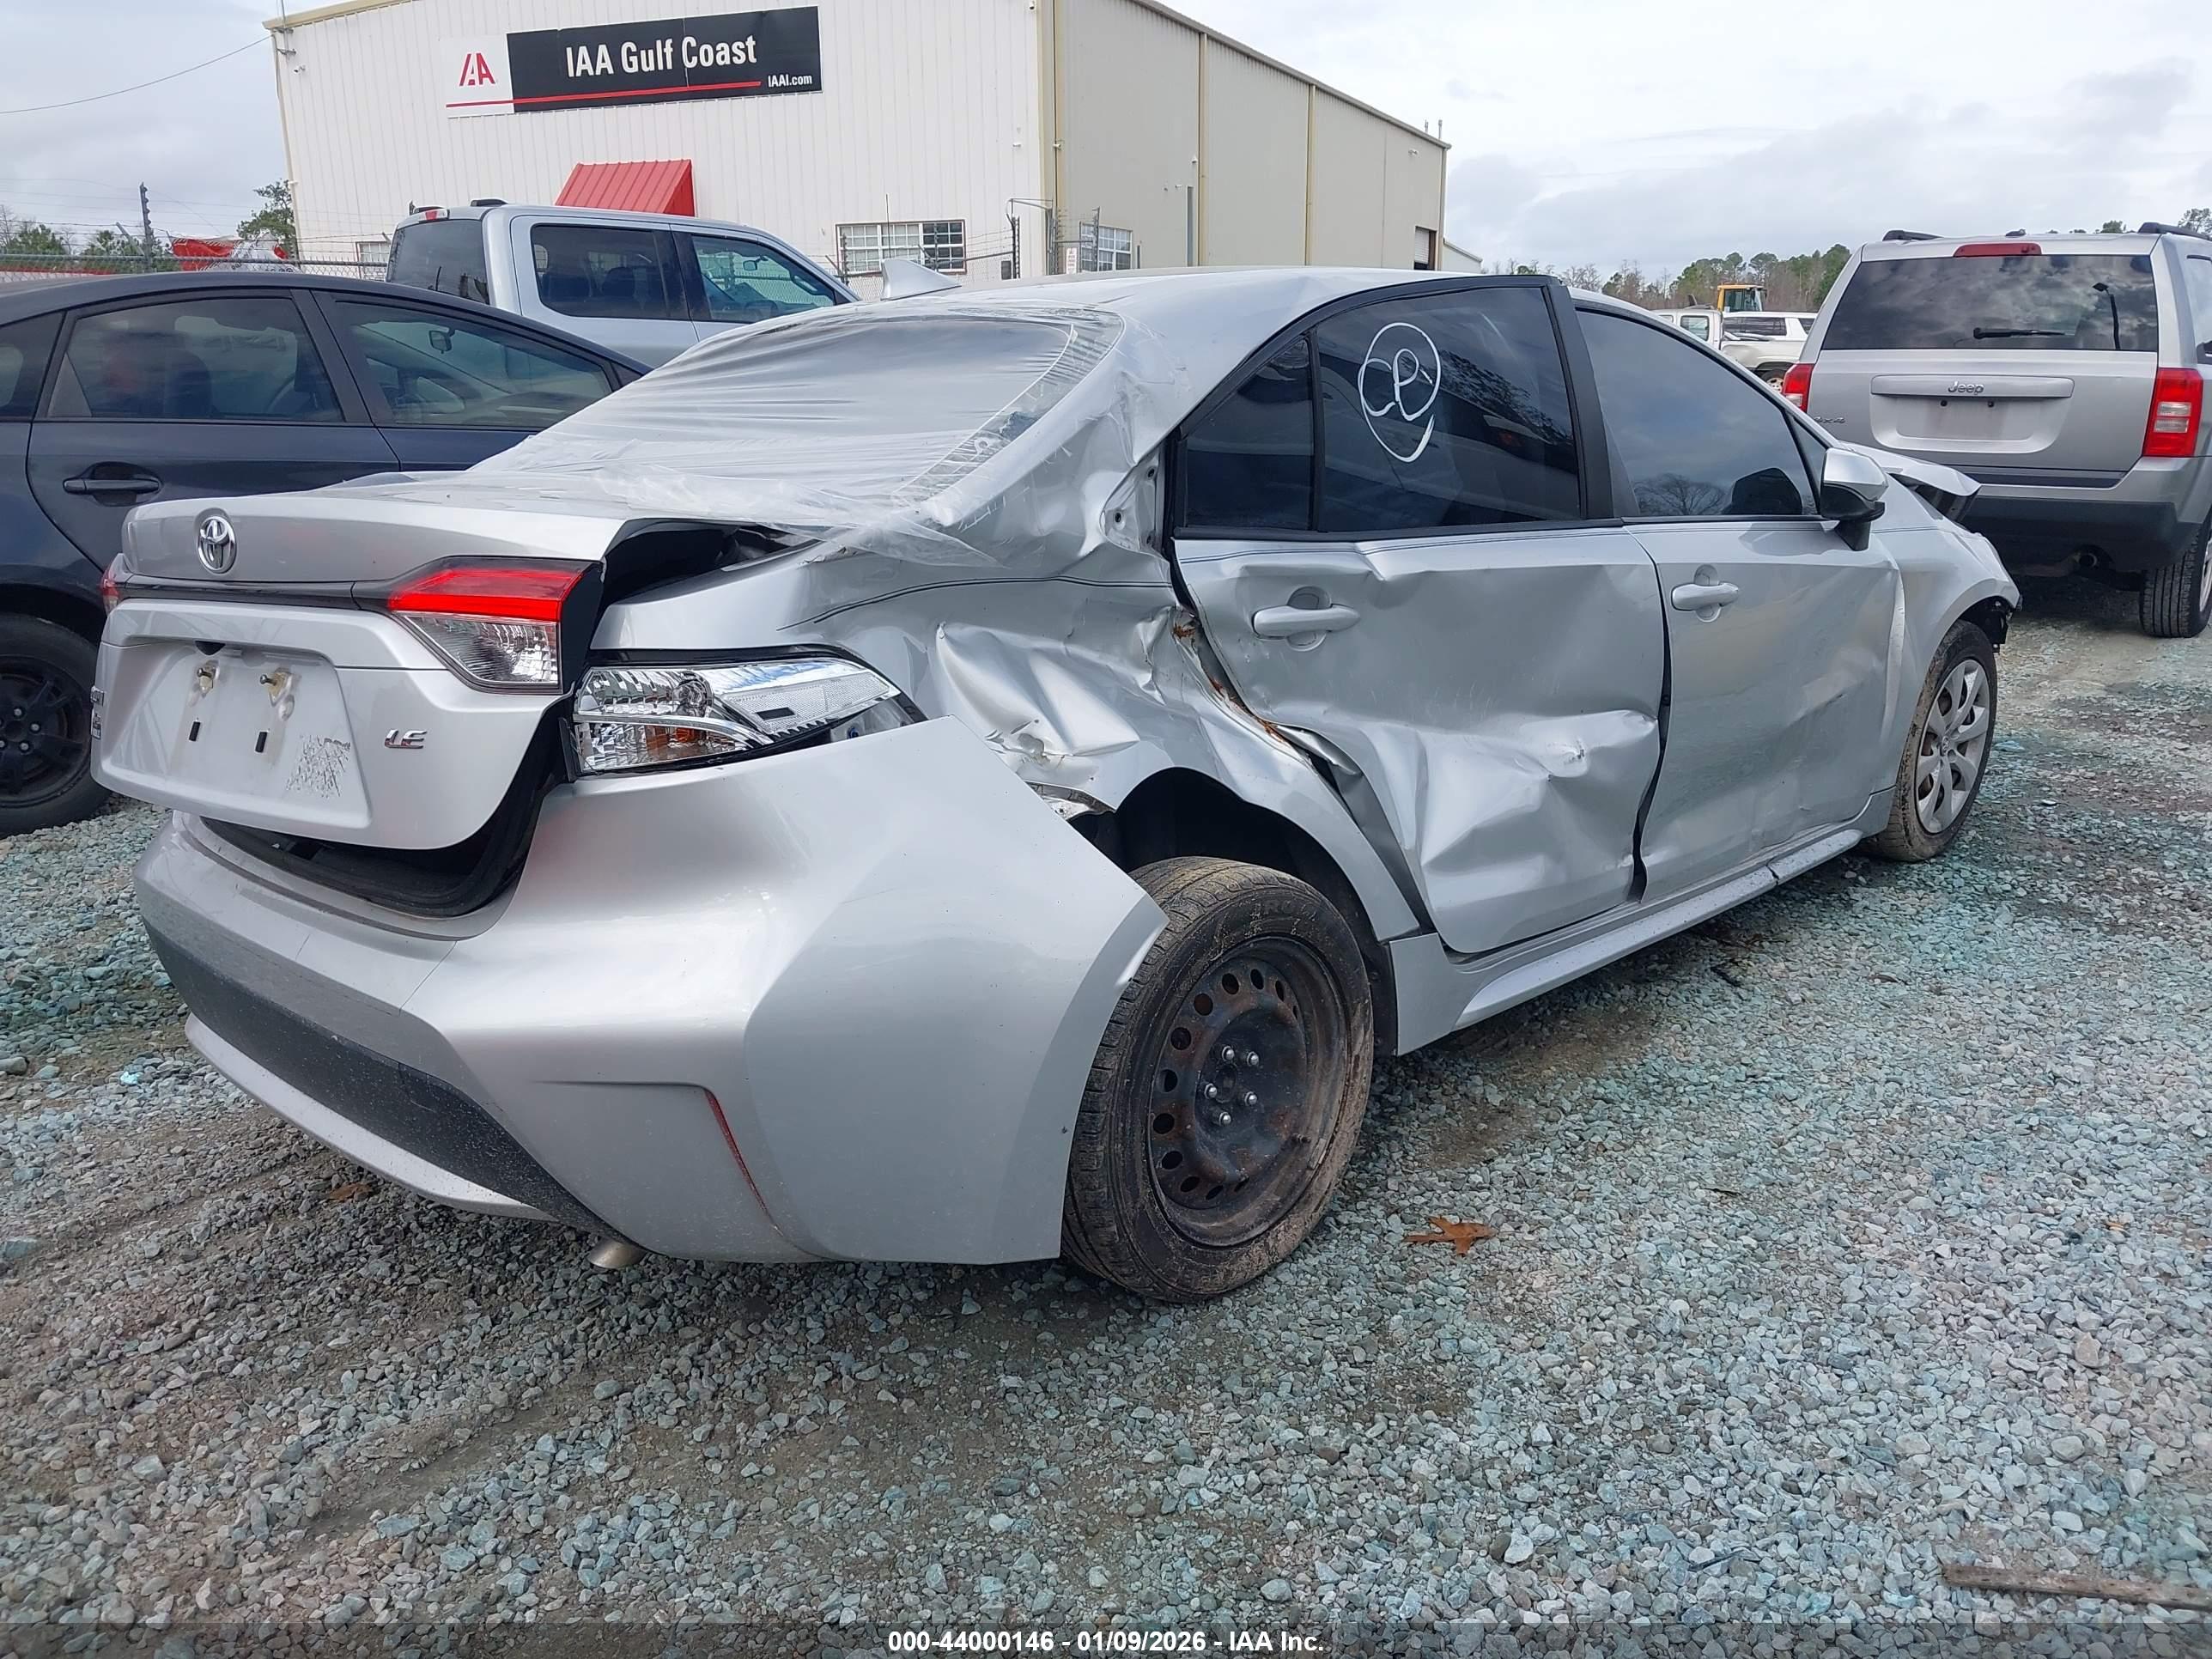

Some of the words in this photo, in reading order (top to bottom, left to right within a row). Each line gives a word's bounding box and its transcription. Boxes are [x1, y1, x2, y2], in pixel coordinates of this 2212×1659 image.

[566, 45, 614, 77] IAA
[621, 41, 673, 74] Gulf
[683, 35, 757, 69] Coast
[768, 74, 812, 88] IAAI.com
[1948, 380, 1984, 396] Jeep
[385, 729, 428, 749] LE
